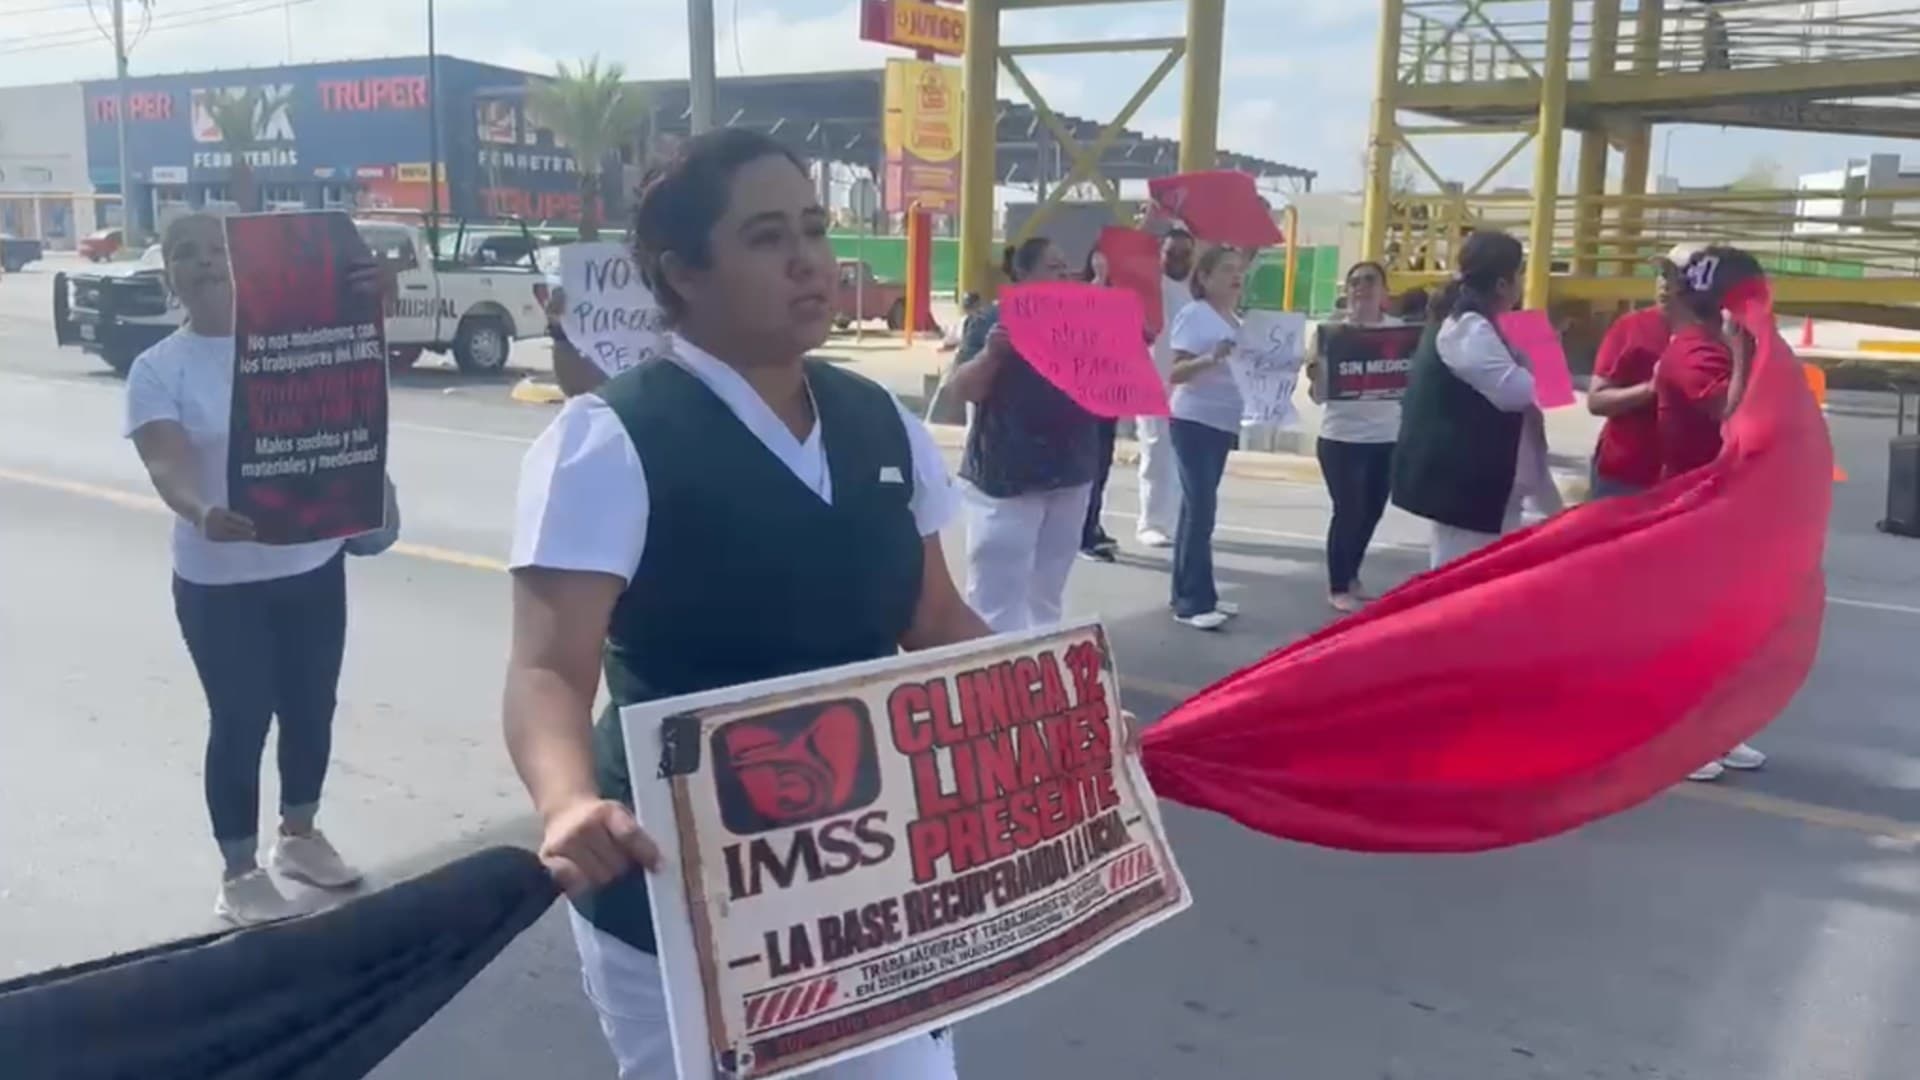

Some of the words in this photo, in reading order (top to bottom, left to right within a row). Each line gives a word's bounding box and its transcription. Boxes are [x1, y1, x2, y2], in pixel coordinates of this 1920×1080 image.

[317, 75, 427, 111] TRUPER
[585, 257, 630, 293] NO
[240, 355, 260, 373] los
[262, 351, 333, 373] trabajadores
[1339, 361, 1363, 375] SIN
[255, 436, 294, 454] Malos
[343, 431, 350, 449] y
[241, 456, 307, 477] materiales
[309, 457, 316, 475] y
[887, 650, 1070, 756] CLINICA
[909, 701, 1112, 820] LINARES
[906, 768, 1121, 885] PRESENTE
[722, 810, 895, 902] IMSS
[764, 923, 815, 979] LA
[817, 897, 902, 963] BASE
[903, 837, 1069, 937] RECUPERANDO
[861, 934, 967, 980] TRABAJADORAS
[969, 927, 978, 947] Y
